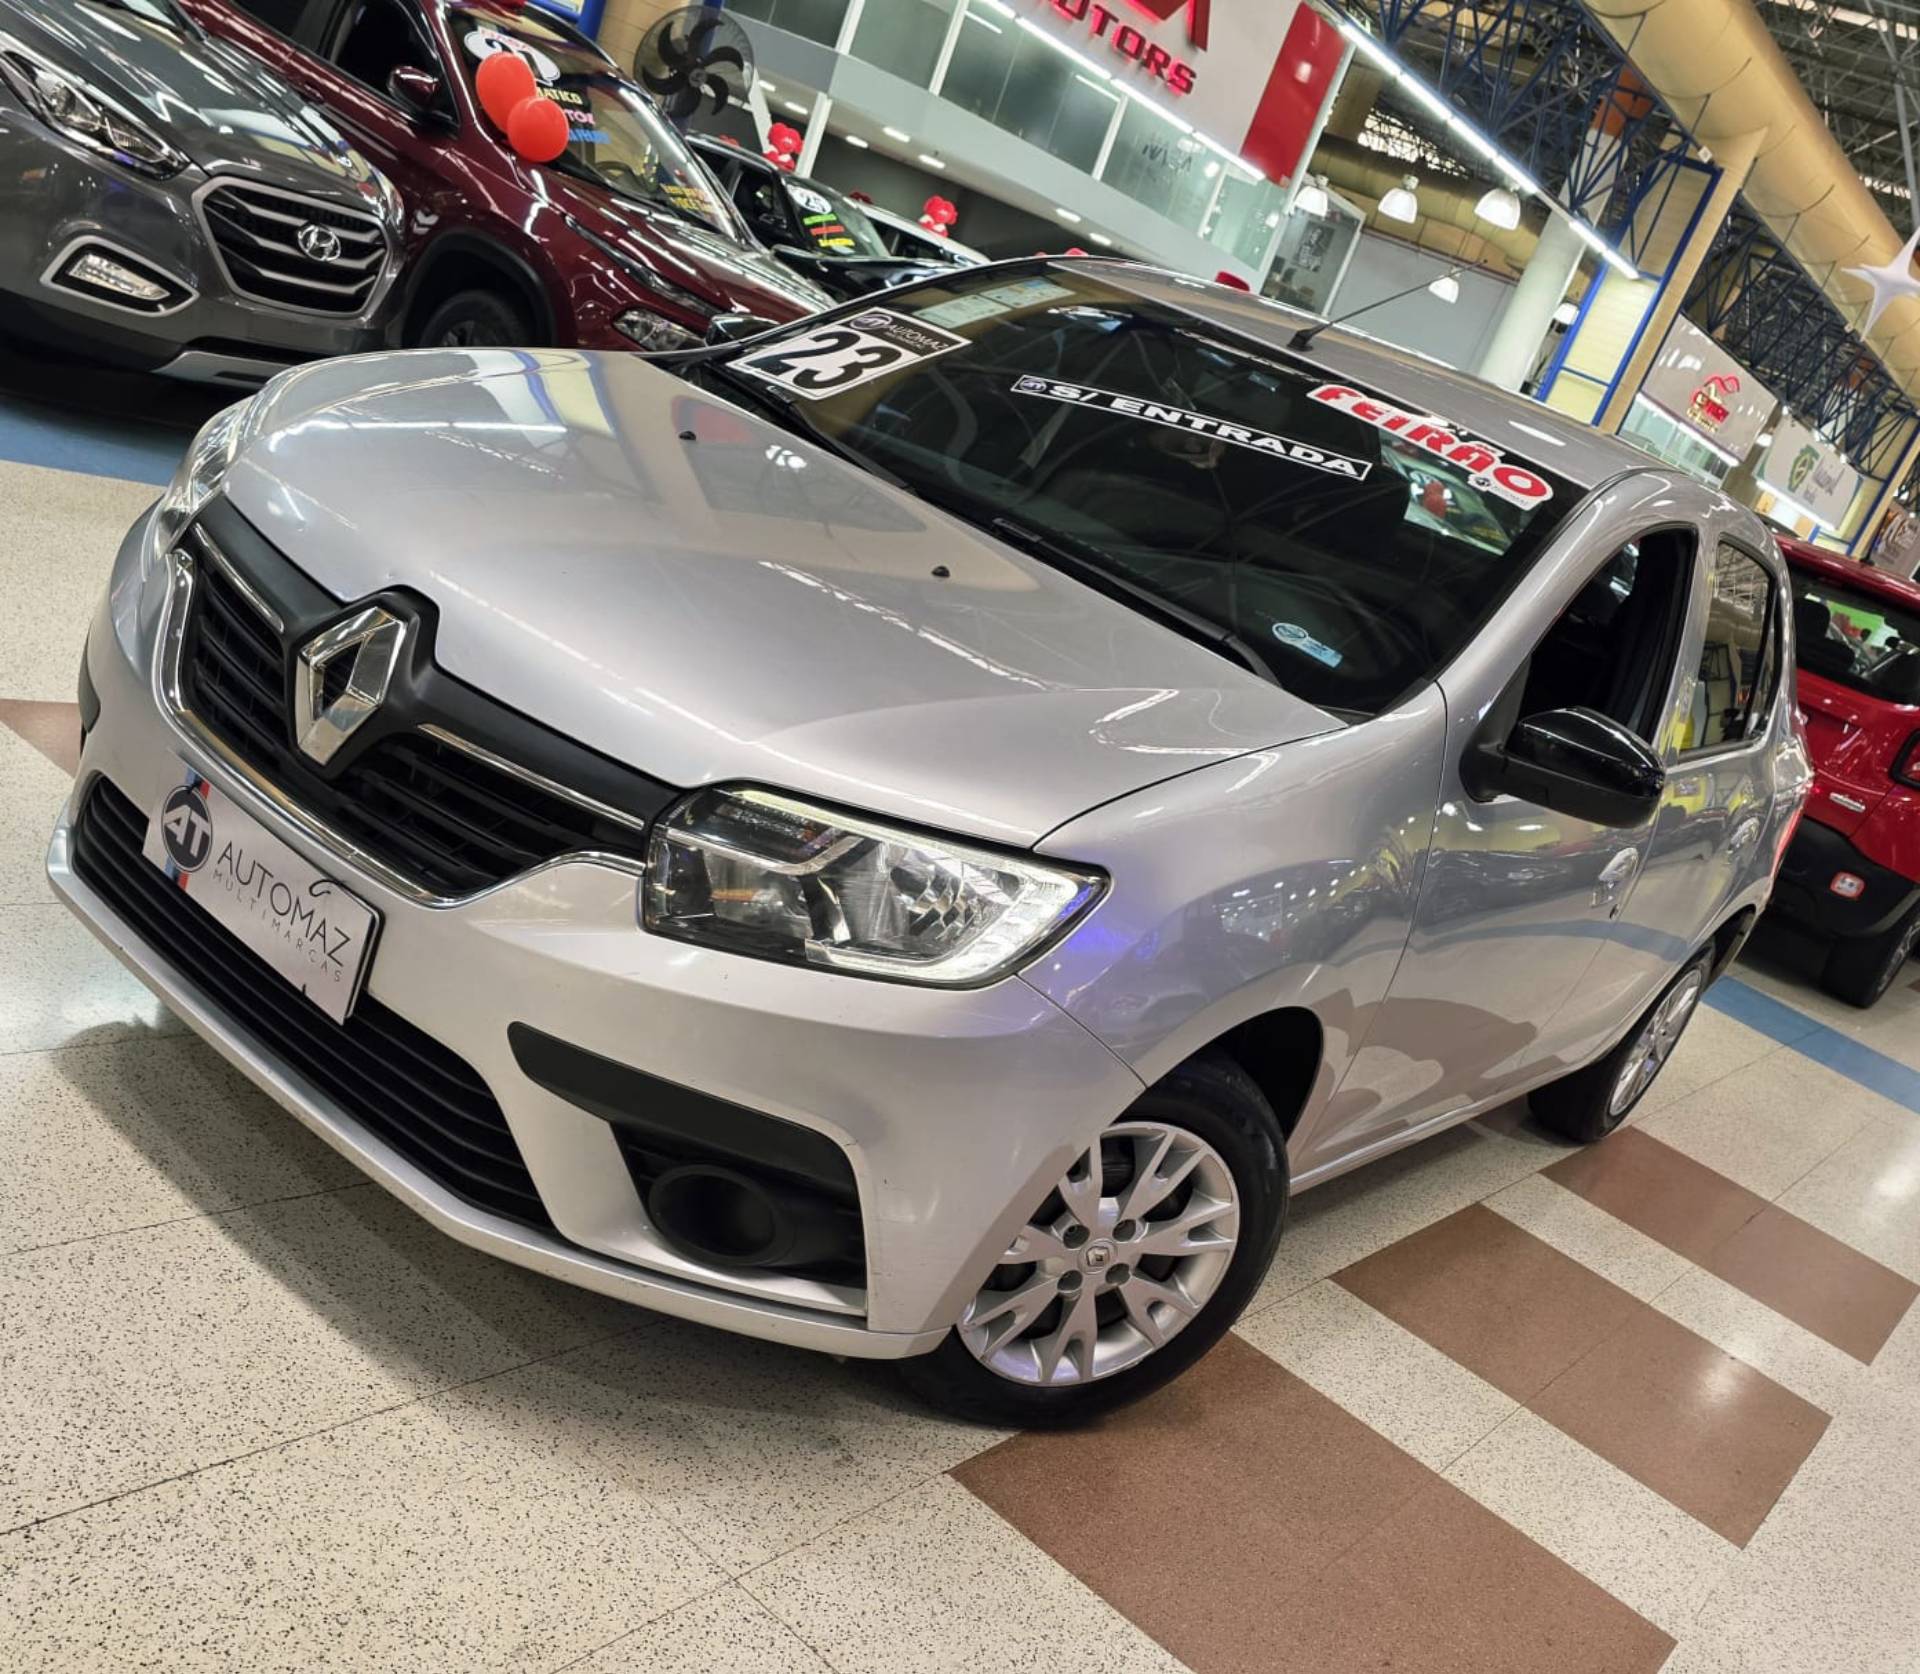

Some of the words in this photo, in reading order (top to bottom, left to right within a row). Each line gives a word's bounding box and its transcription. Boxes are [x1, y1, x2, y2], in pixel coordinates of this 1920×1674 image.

[1050, 0, 1197, 95] OTORS
[743, 330, 902, 389] 23
[1110, 396, 1359, 477] ENTRADA
[212, 868, 342, 983] MULTIMARCAS
[217, 840, 351, 967] AUTOMAZ
